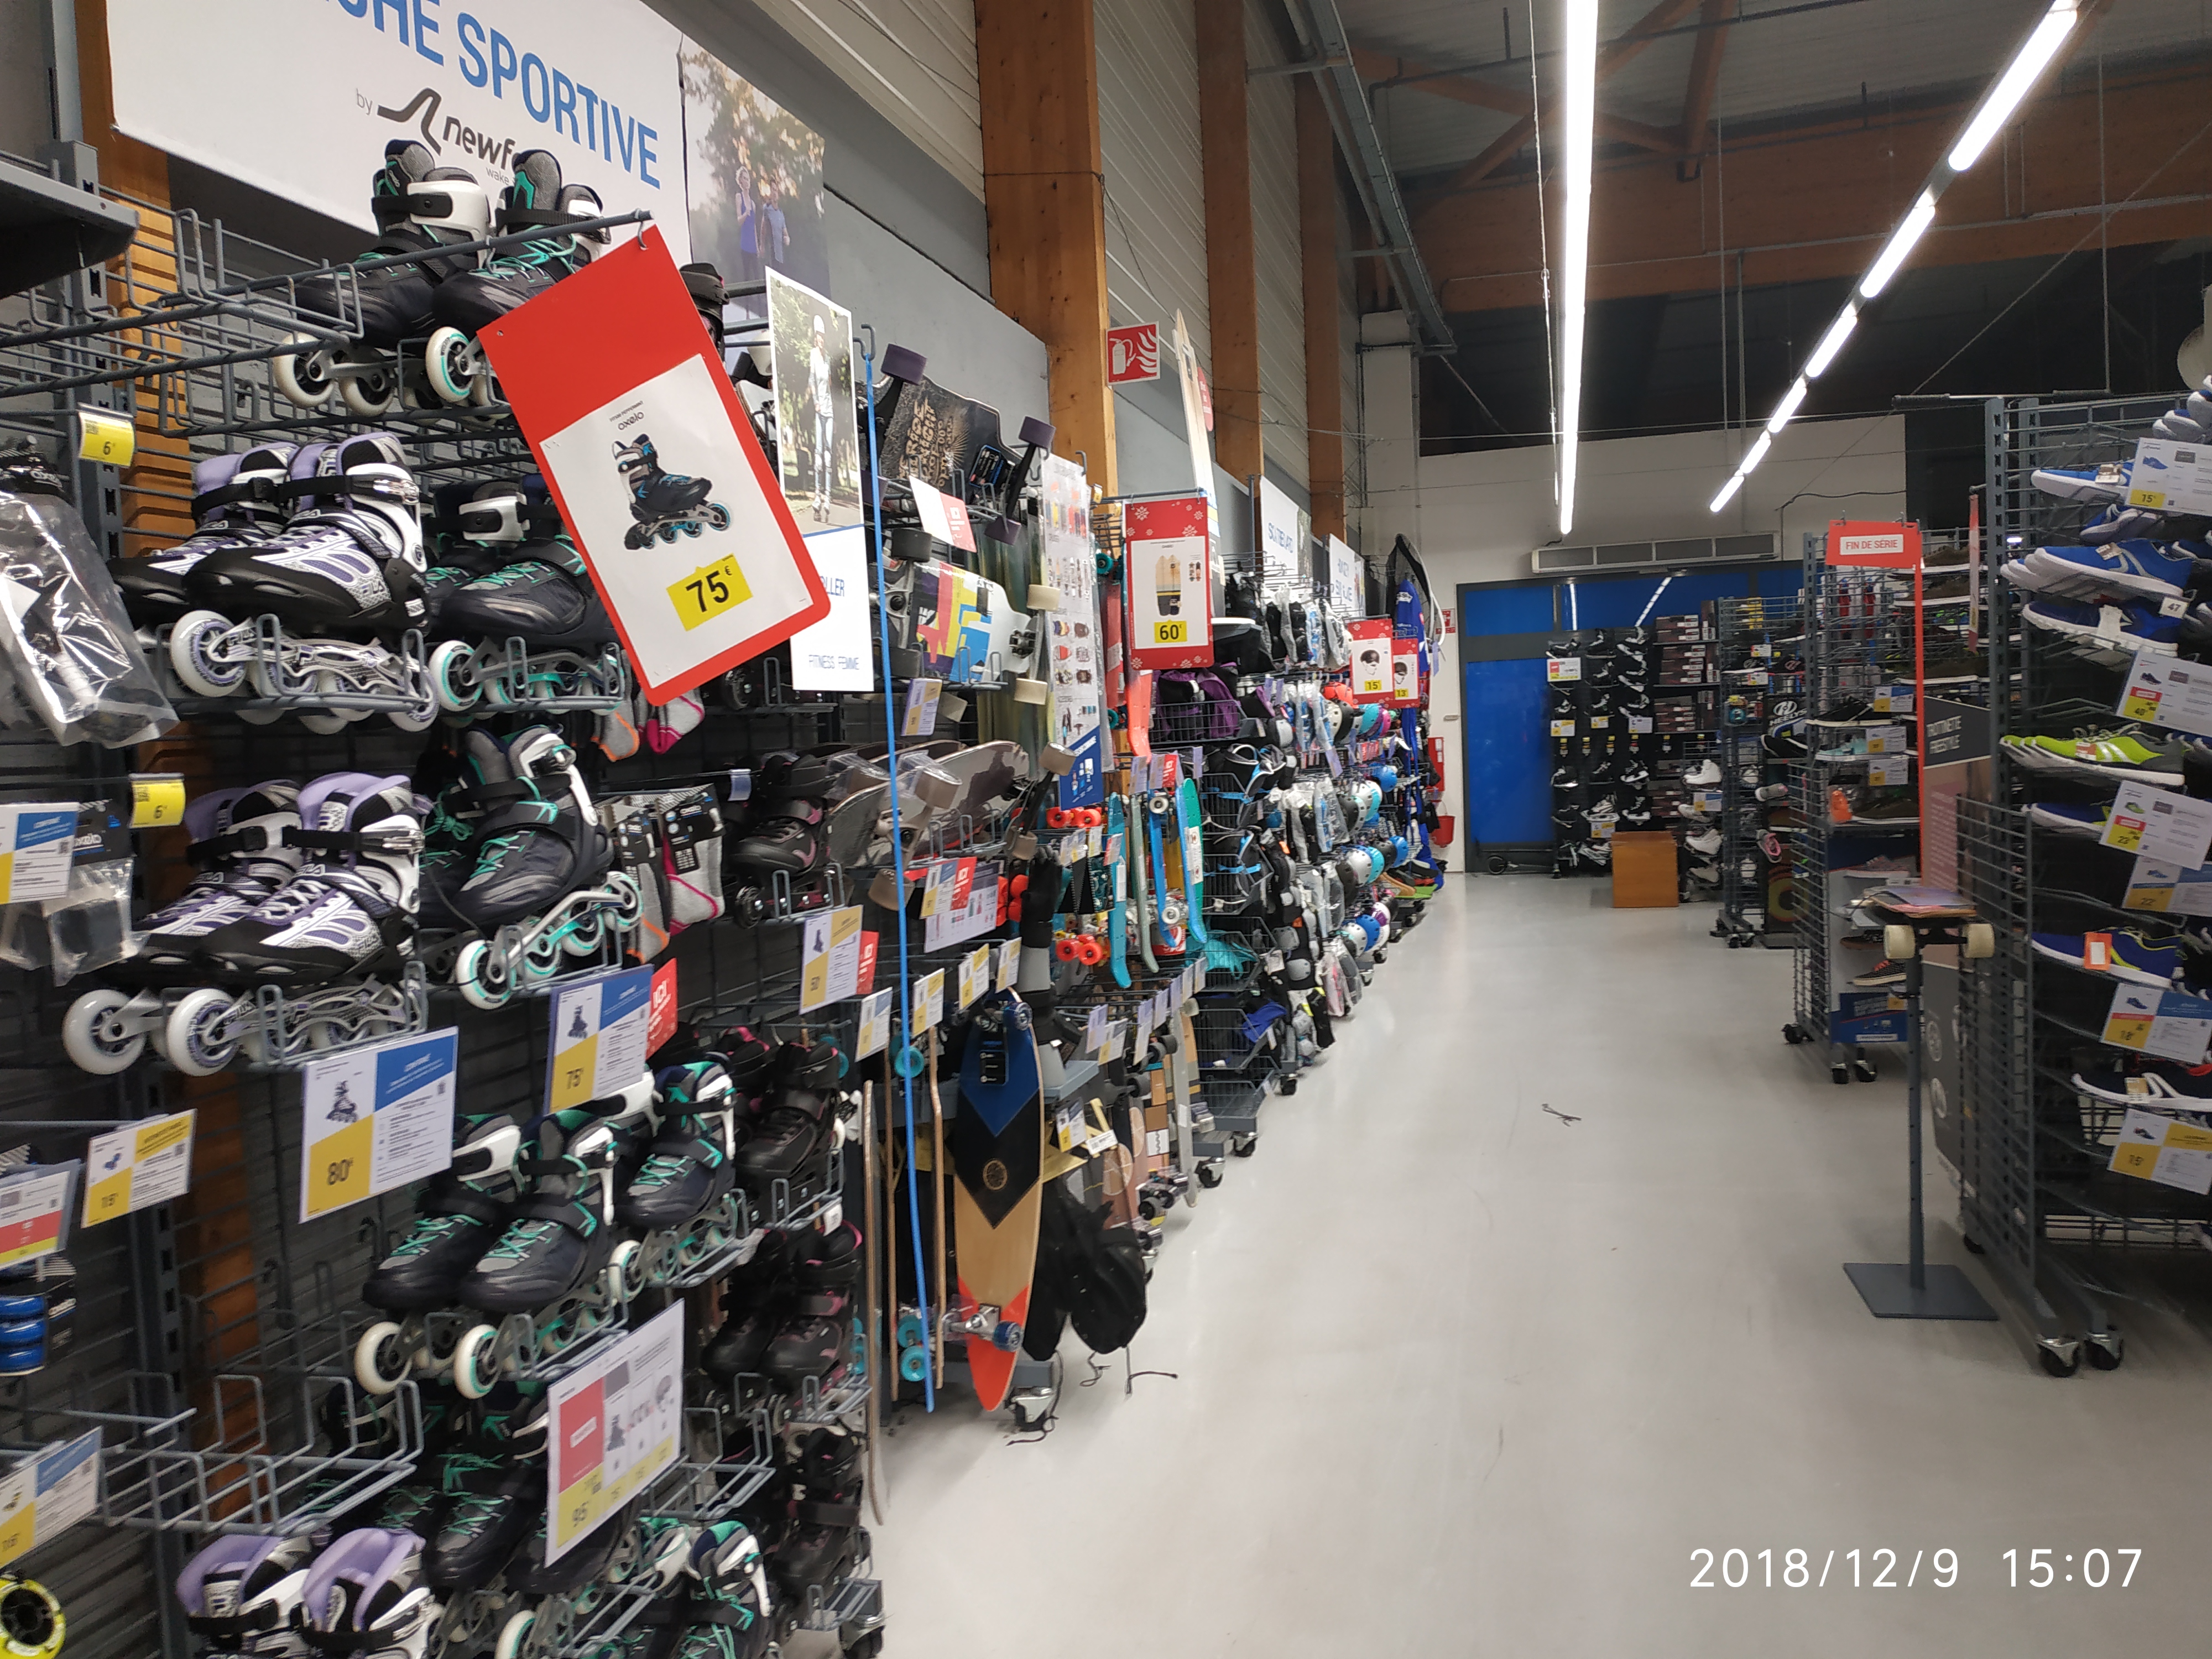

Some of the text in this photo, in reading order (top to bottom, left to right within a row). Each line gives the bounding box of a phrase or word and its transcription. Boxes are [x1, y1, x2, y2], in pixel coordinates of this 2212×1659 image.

[356, 88, 373, 116] by
[457, 12, 661, 190] SPORTIVE
[442, 115, 517, 170] newf
[486, 167, 510, 186] wake
[1845, 541, 1860, 550] FIN
[1861, 540, 1872, 550] DE
[820, 575, 845, 597] LLER
[1768, 708, 1808, 727] HEELYS
